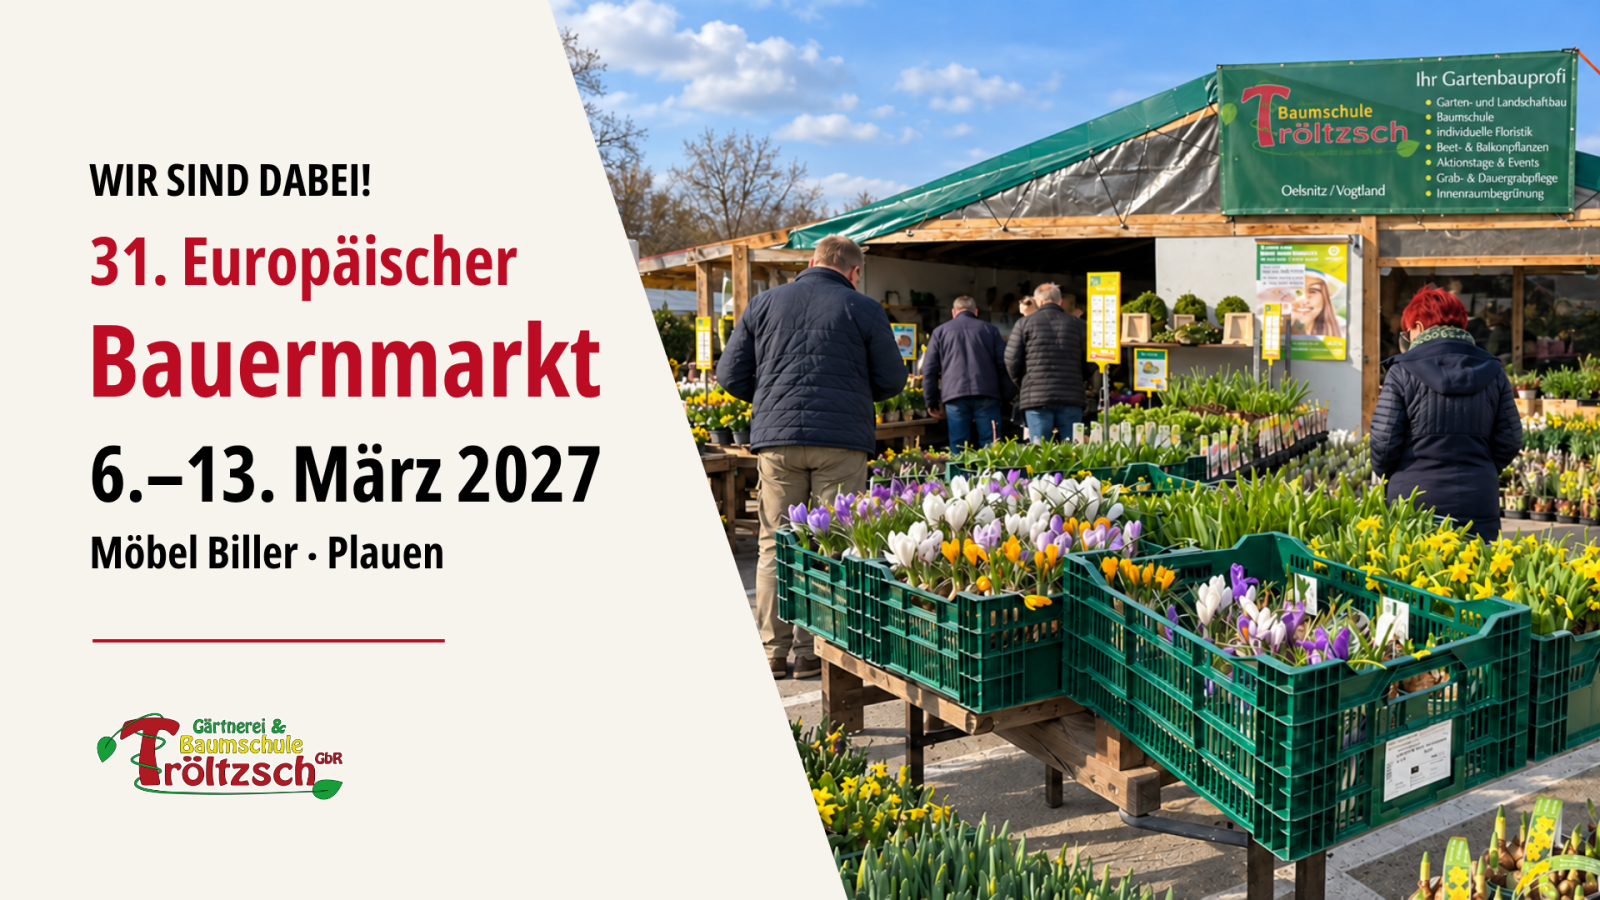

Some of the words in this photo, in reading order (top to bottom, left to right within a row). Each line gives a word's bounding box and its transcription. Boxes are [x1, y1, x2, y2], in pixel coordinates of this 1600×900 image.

[1416, 70, 1438, 87] Ihr
[1442, 67, 1567, 90] Gartenbauprofi
[1436, 96, 1473, 108] Garten-
[1475, 96, 1495, 107] und
[1497, 97, 1567, 107] Landschaftbau
[1241, 84, 1408, 147] Tröltzsch
[1278, 103, 1373, 120] Baumschule
[1436, 111, 1495, 122] Baumschule
[1436, 126, 1493, 137] individuelle
[1495, 126, 1533, 137] Floristik
[1436, 142, 1462, 152] Beet-
[1464, 142, 1474, 152] &
[1476, 141, 1549, 154] Balkonpflanzen
[1436, 157, 1495, 170] Aktionstage
[1496, 157, 1505, 168] &
[1508, 157, 1540, 168] Events
[1436, 172, 1464, 183] Grab-
[1466, 173, 1475, 183] &
[1478, 172, 1558, 186] Dauergrabpflege
[1436, 187, 1545, 201] Innenraumbegrünung
